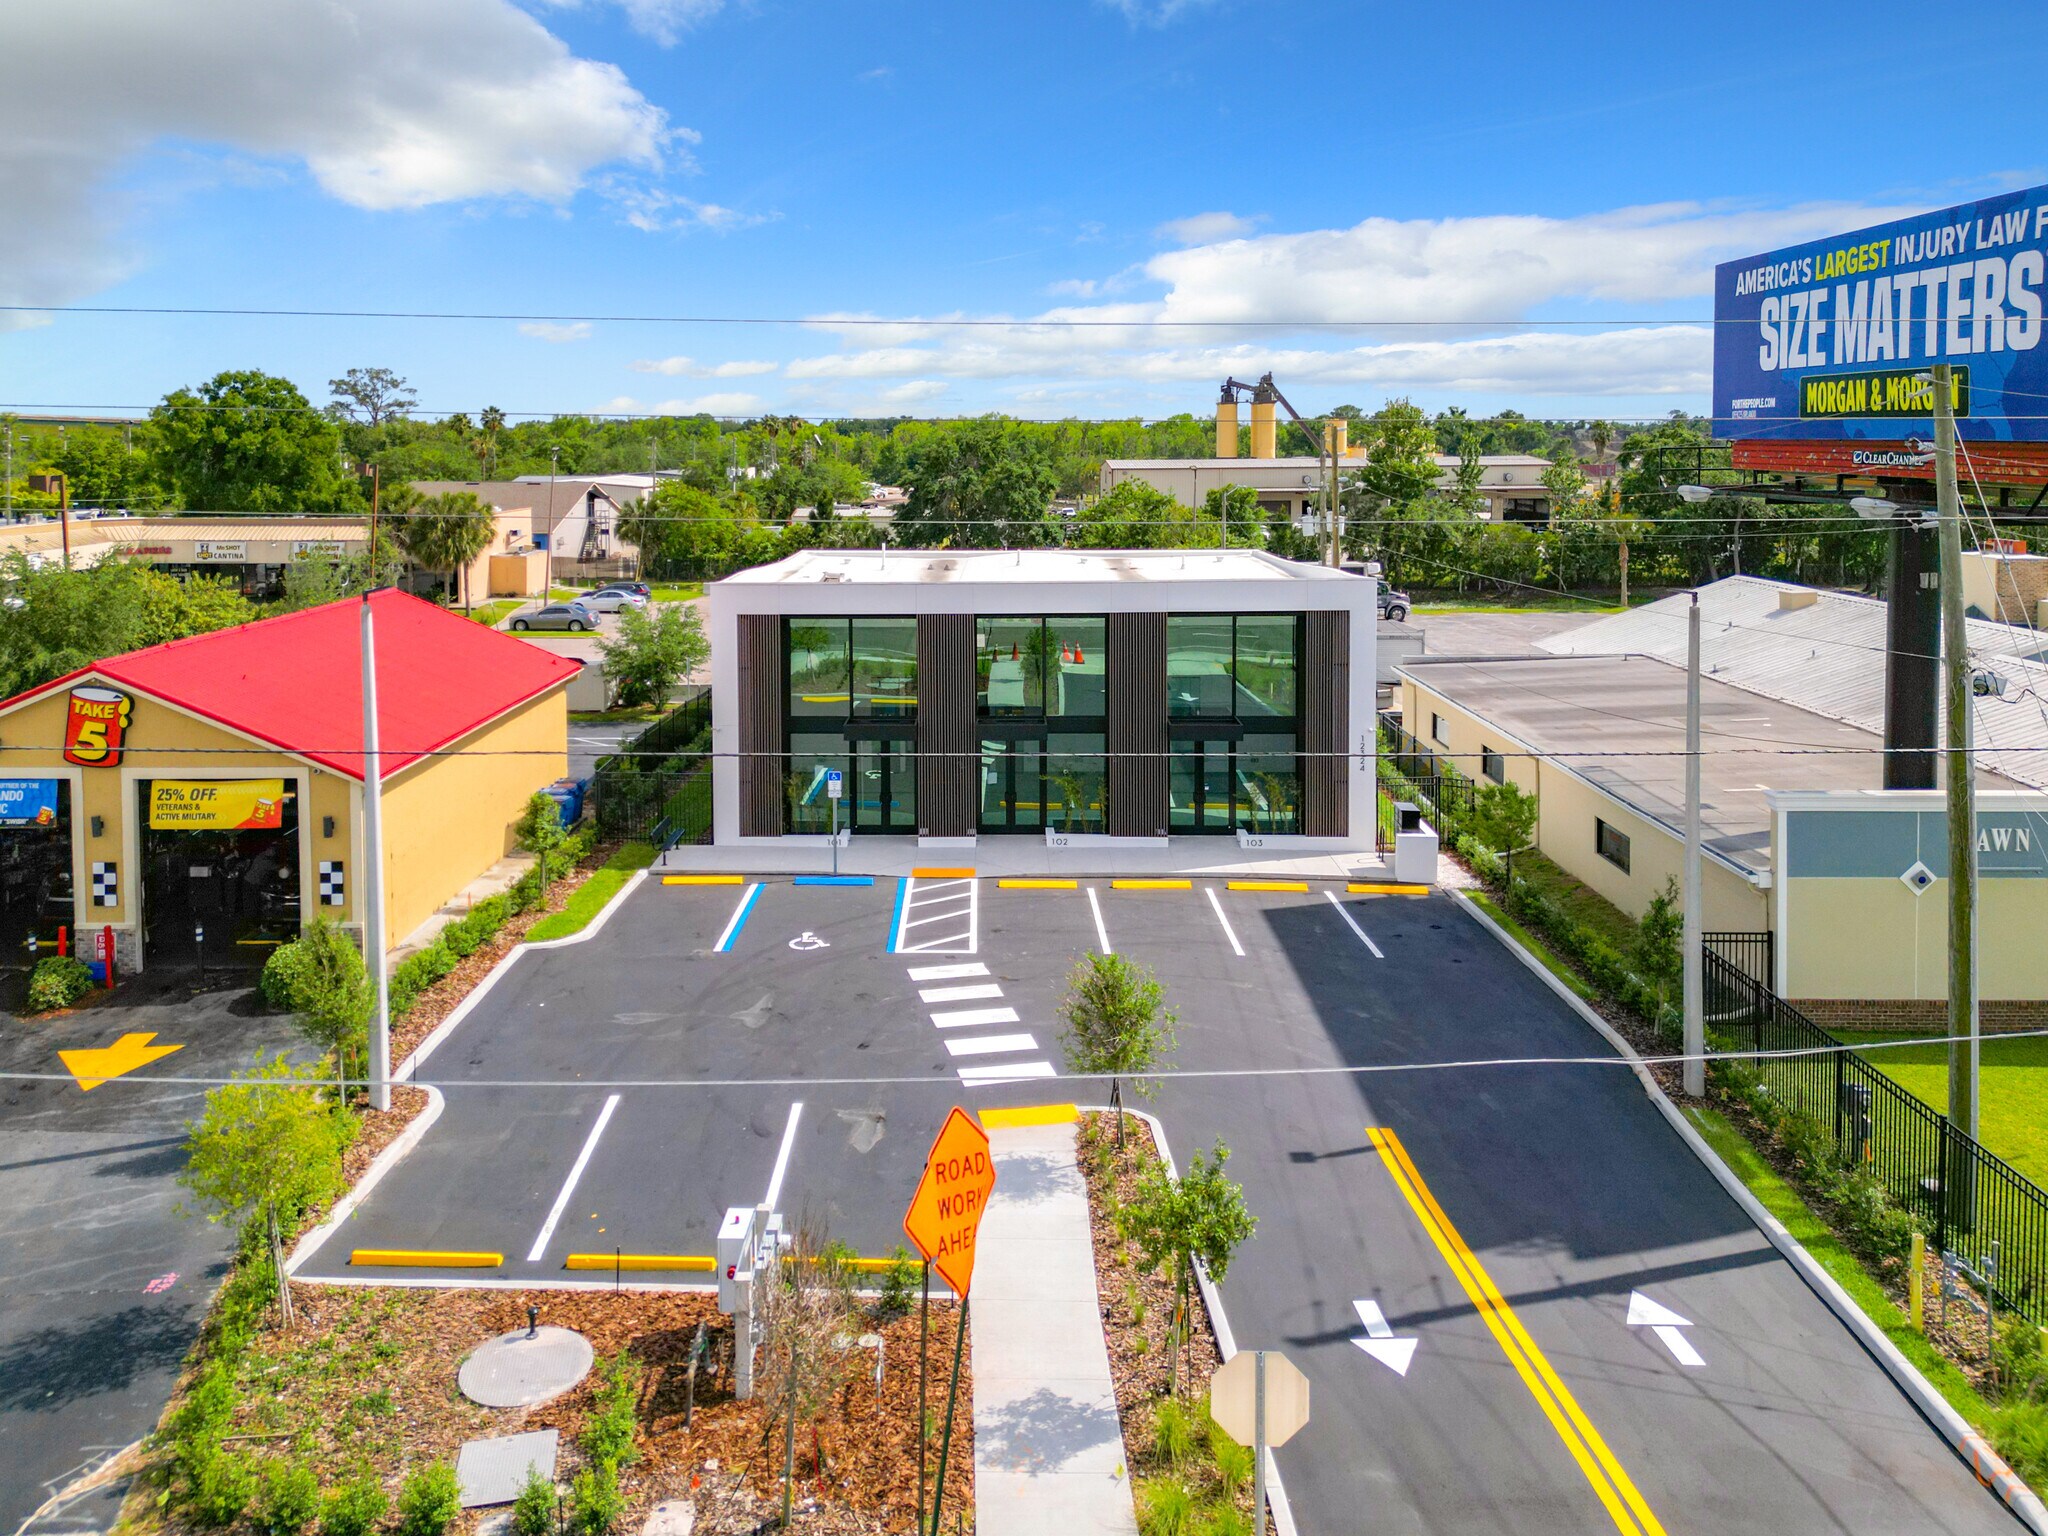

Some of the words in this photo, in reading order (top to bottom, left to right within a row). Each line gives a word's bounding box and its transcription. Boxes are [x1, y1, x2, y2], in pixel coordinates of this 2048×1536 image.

[1735, 257, 1812, 296] AMERICA'S
[1815, 240, 1890, 282] LARGEST
[1894, 221, 1972, 266] INJURY
[1975, 208, 2030, 250] LAW
[1759, 287, 1829, 372] SIZE
[1833, 250, 2045, 365] MATTERS
[1806, 378, 1867, 413] MORGAN
[1870, 378, 1882, 411] &
[1886, 373, 1959, 411] MORGN
[72, 699, 116, 719] TAKE
[72, 720, 108, 761] 5
[157, 788, 185, 802] 25%
[189, 788, 217, 801] OFF.
[155, 812, 181, 821] ACTIVE
[156, 803, 193, 811] VETERANS
[1052, 838, 1068, 846] 102
[1246, 839, 1263, 847] 103
[935, 1151, 986, 1185] ROAD
